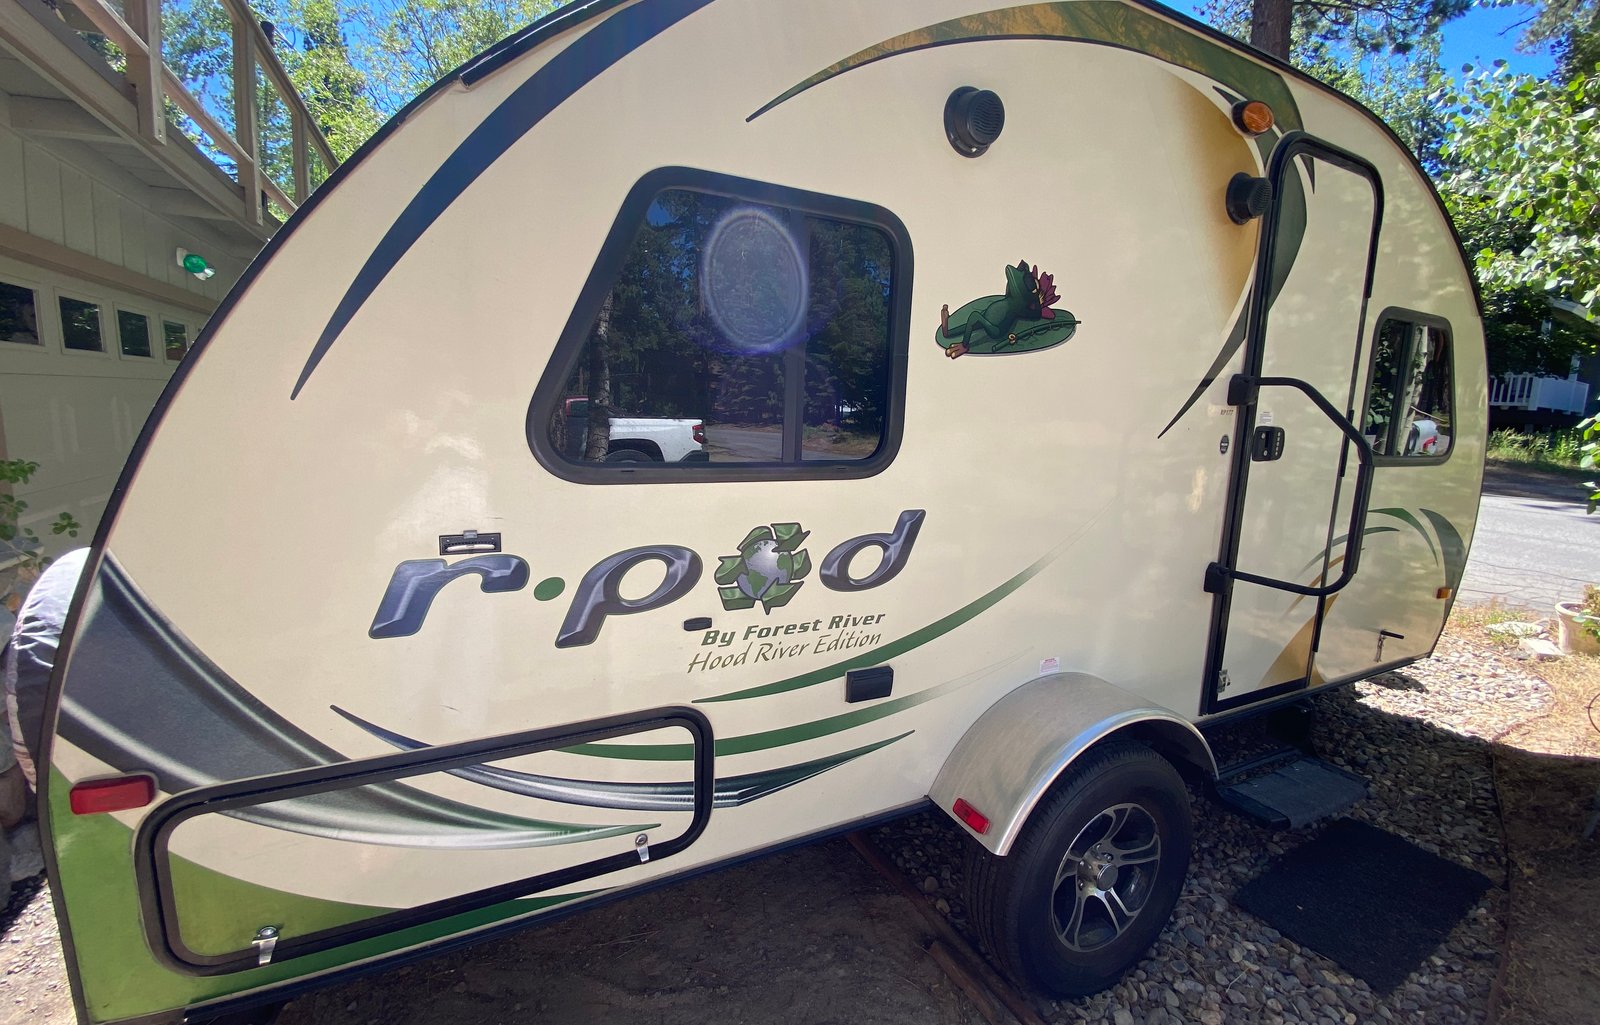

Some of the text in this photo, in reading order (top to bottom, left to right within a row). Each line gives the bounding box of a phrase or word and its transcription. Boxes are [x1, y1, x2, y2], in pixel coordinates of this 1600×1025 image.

[701, 613, 886, 647] By Forest River
[687, 629, 882, 674] Hood River Edition
